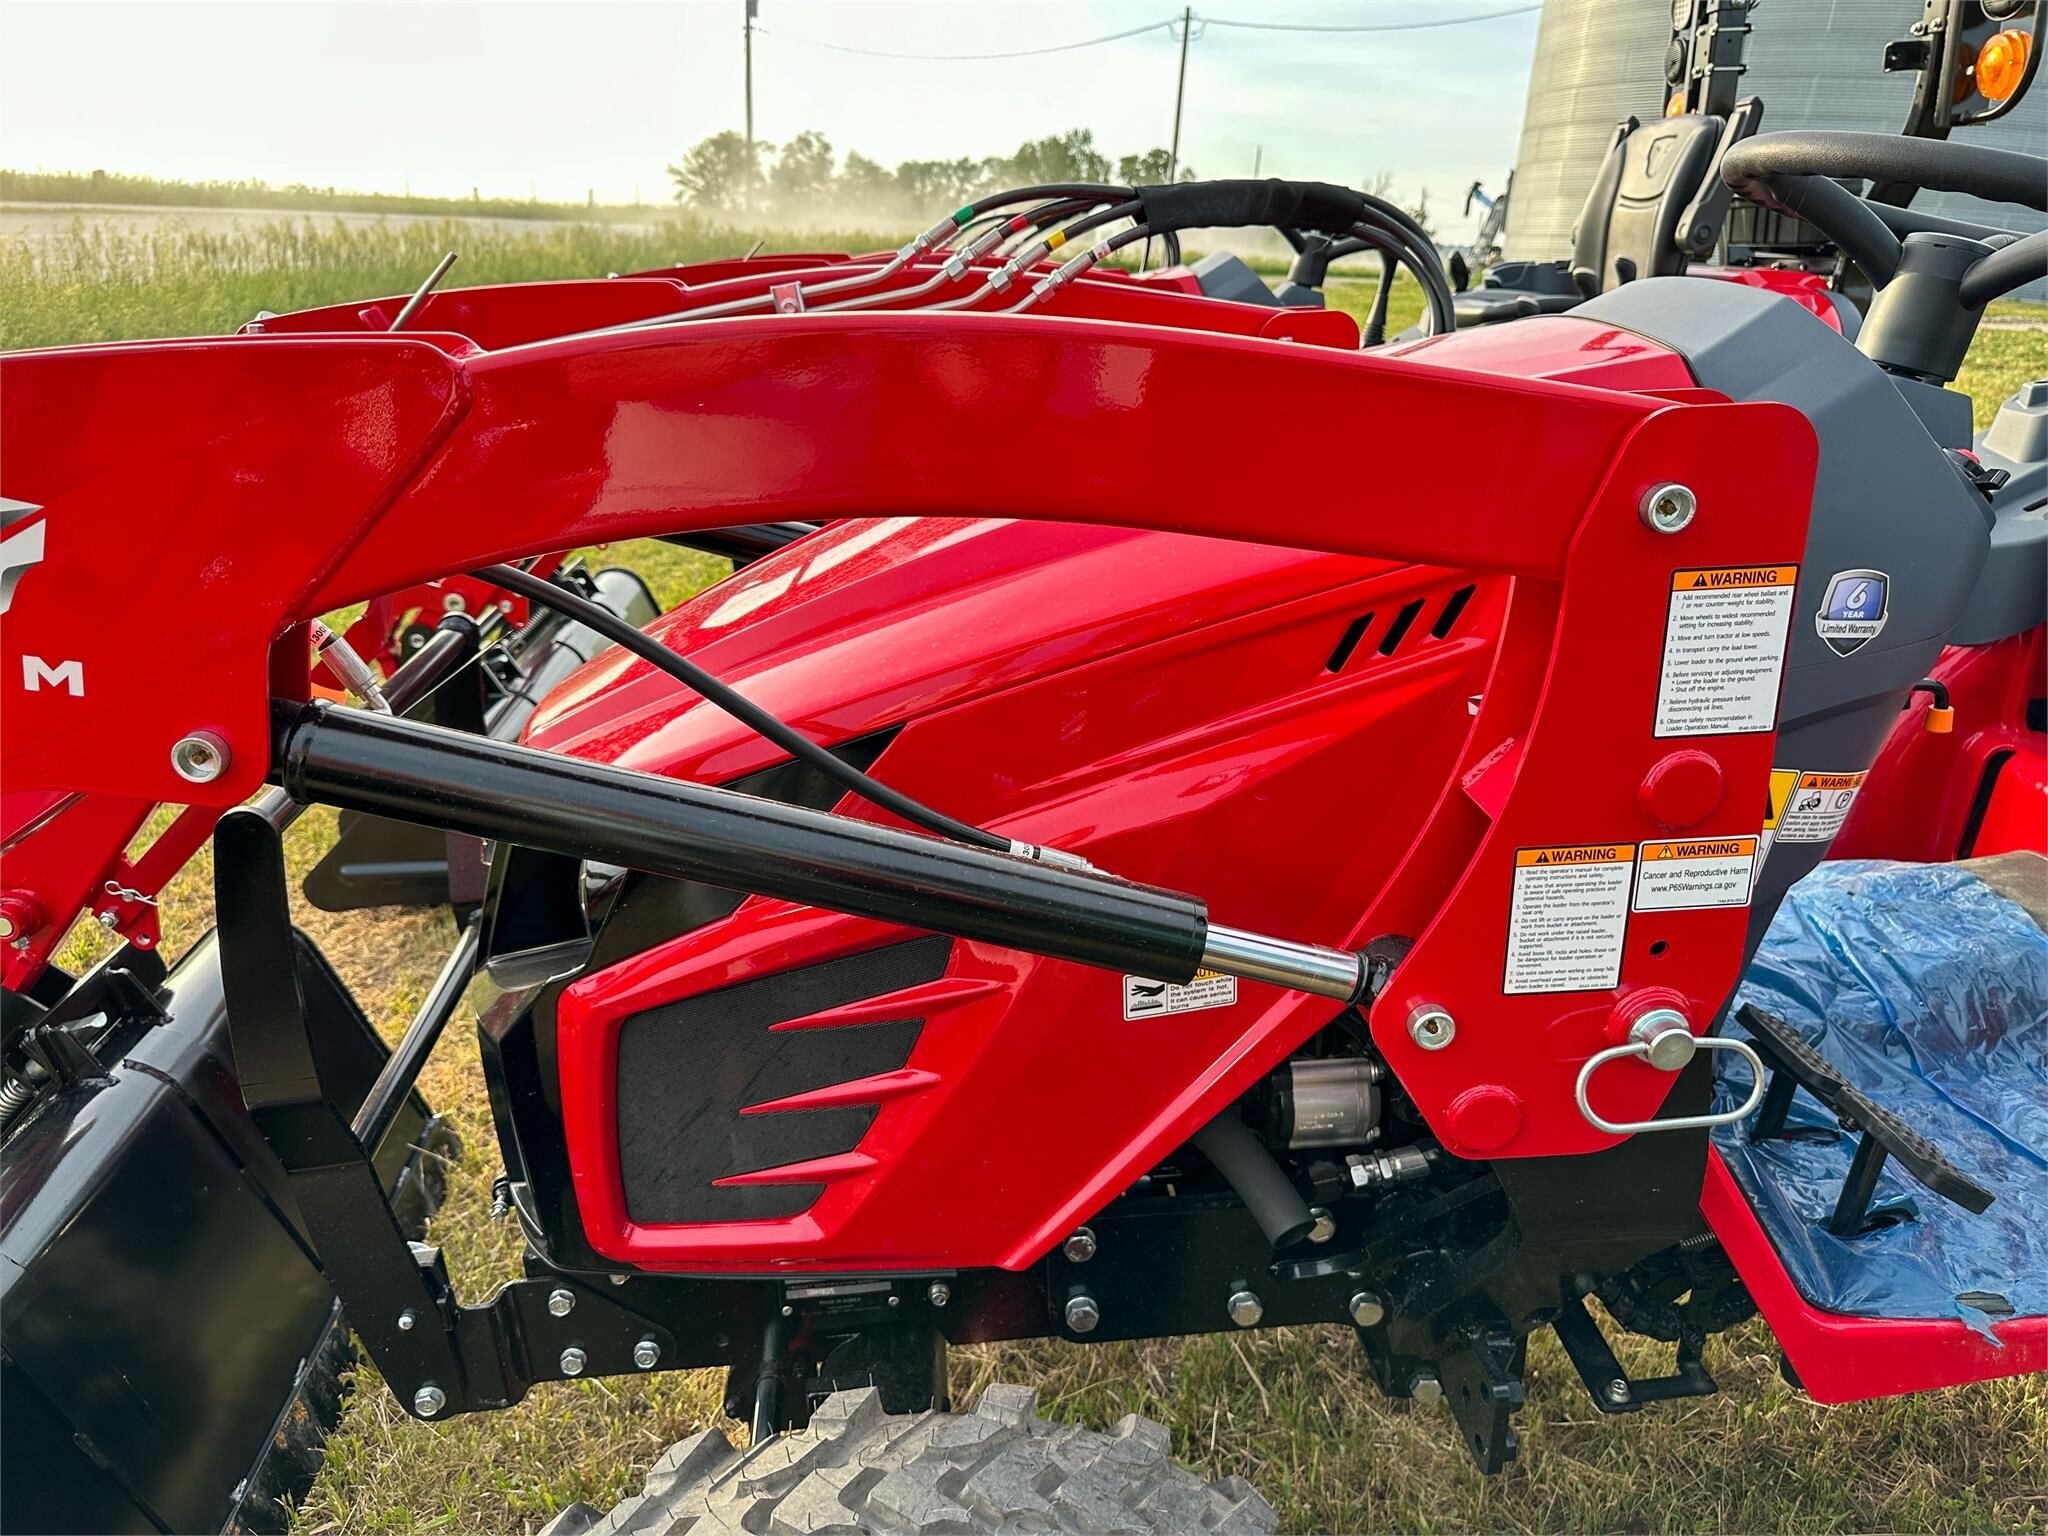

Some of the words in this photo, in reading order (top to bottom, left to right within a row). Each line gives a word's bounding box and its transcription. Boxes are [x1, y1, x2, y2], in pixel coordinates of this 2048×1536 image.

[1710, 570, 1778, 586] WARNING
[1846, 581, 1870, 610] 6
[1822, 624, 1847, 634] Limited
[1848, 624, 1877, 635] Warranty
[22, 655, 84, 697] M
[1820, 776, 1862, 788] WARNING
[1552, 848, 1616, 862] WARNING
[1676, 843, 1740, 855] WARNING
[1643, 872, 1667, 880] Cancer
[1669, 870, 1682, 878] and
[1684, 869, 1728, 878] Reproductive
[1651, 882, 1737, 892] www.P65Warnings.ca.gov
